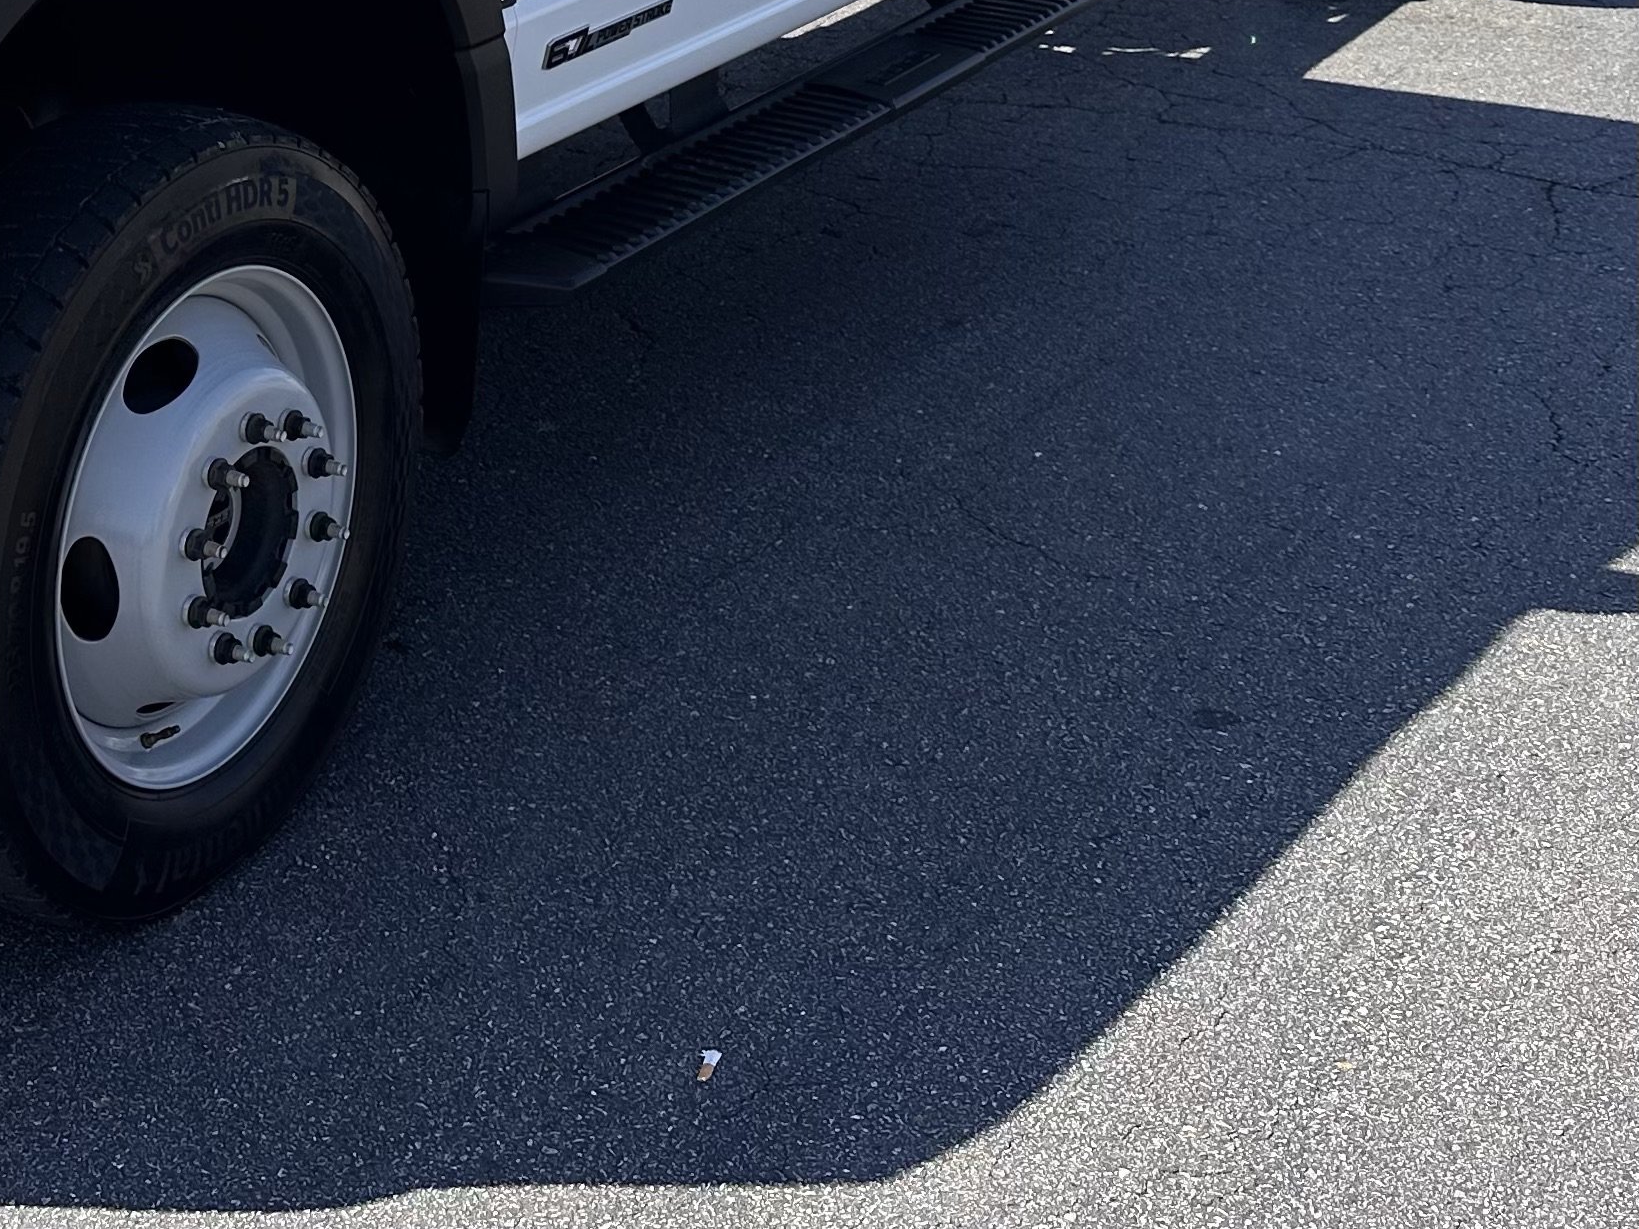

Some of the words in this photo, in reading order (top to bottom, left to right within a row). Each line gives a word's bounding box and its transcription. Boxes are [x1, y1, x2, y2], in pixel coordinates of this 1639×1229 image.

[161, 193, 222, 255] Conti
[225, 177, 274, 216] HDR
[277, 177, 289, 207] 5
